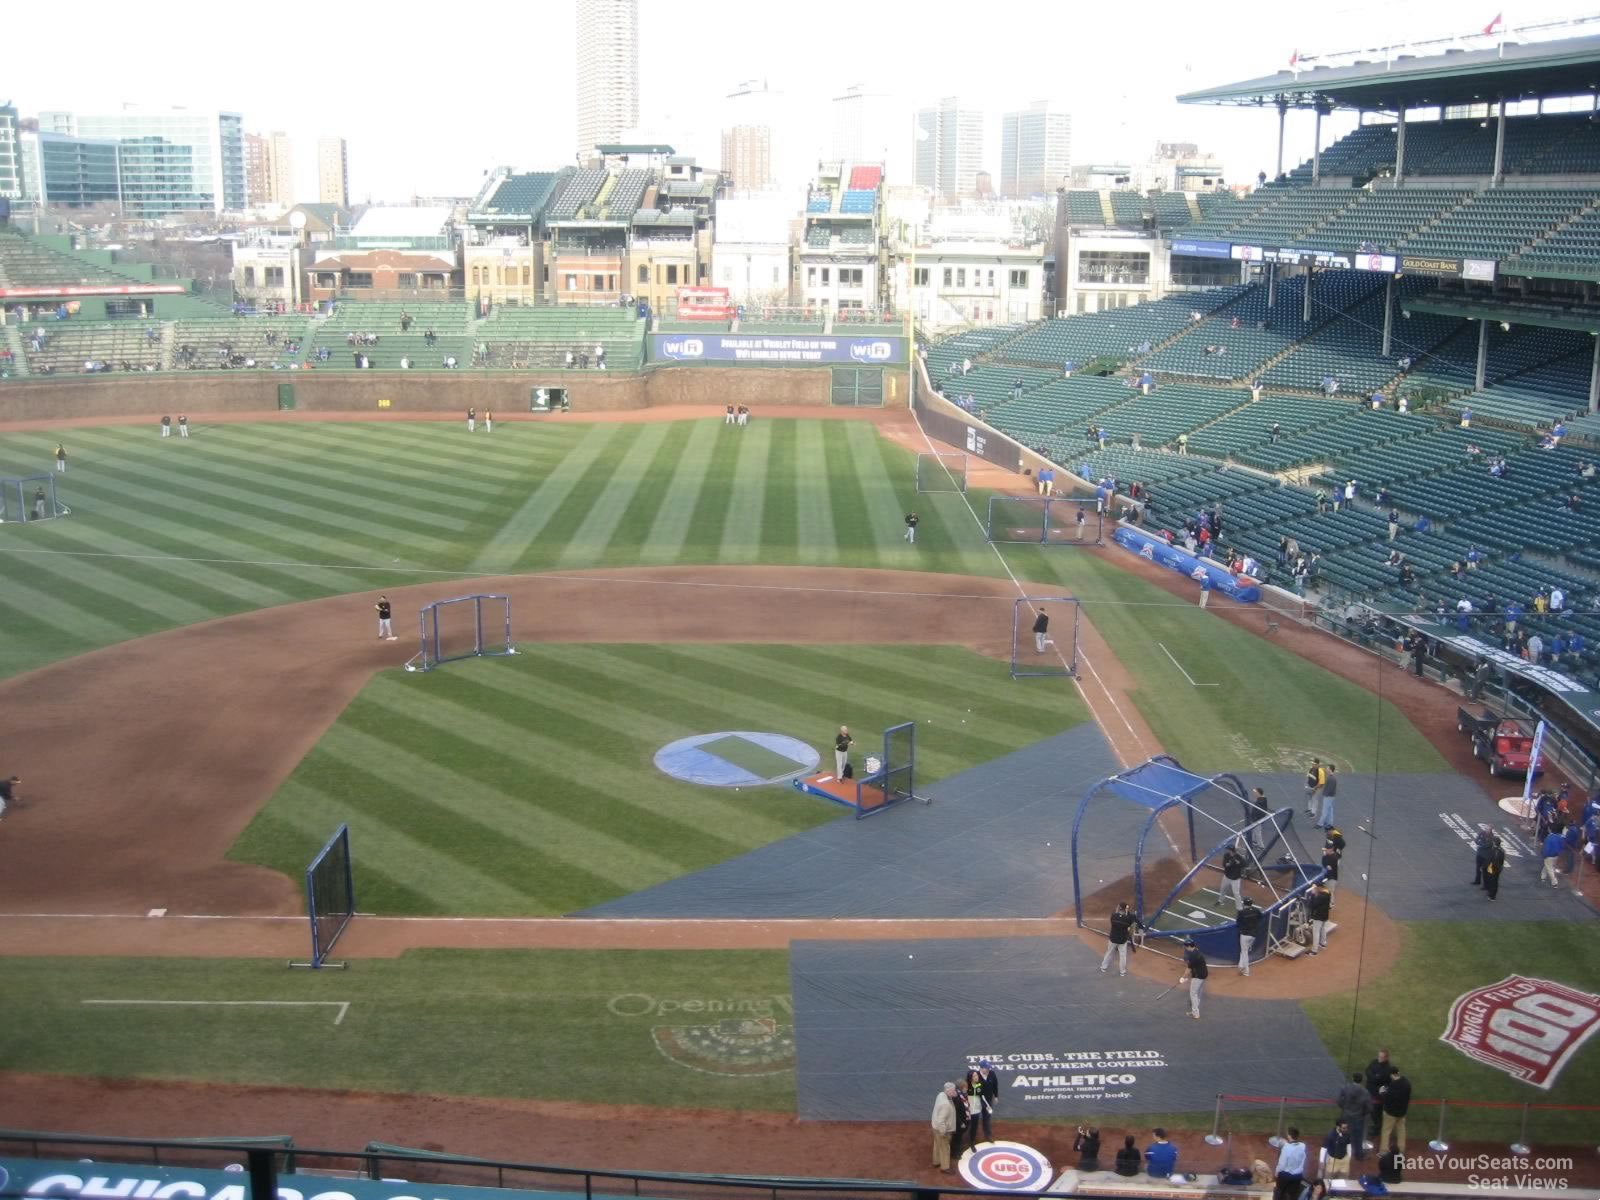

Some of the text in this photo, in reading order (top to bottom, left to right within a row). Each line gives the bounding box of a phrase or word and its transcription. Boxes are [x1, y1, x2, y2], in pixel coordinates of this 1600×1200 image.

[1403, 260, 1457, 270] GOLD COAST BANK
[763, 339, 791, 348] WRIGLEY
[792, 340, 809, 348] FIELD
[607, 993, 774, 1017] Opening
[1459, 983, 1536, 1045] WRIGLEY FIELD
[1486, 993, 1597, 1066] 100
[966, 1050, 1165, 1063] THE CUBS. THE FIELD.
[968, 1063, 1015, 1071] W'VE
[1051, 1061, 1094, 1069] THEM
[1096, 1059, 1169, 1068] COVERED.
[1011, 1073, 1136, 1087] ATHLETICO
[1104, 1091, 1132, 1099] body.
